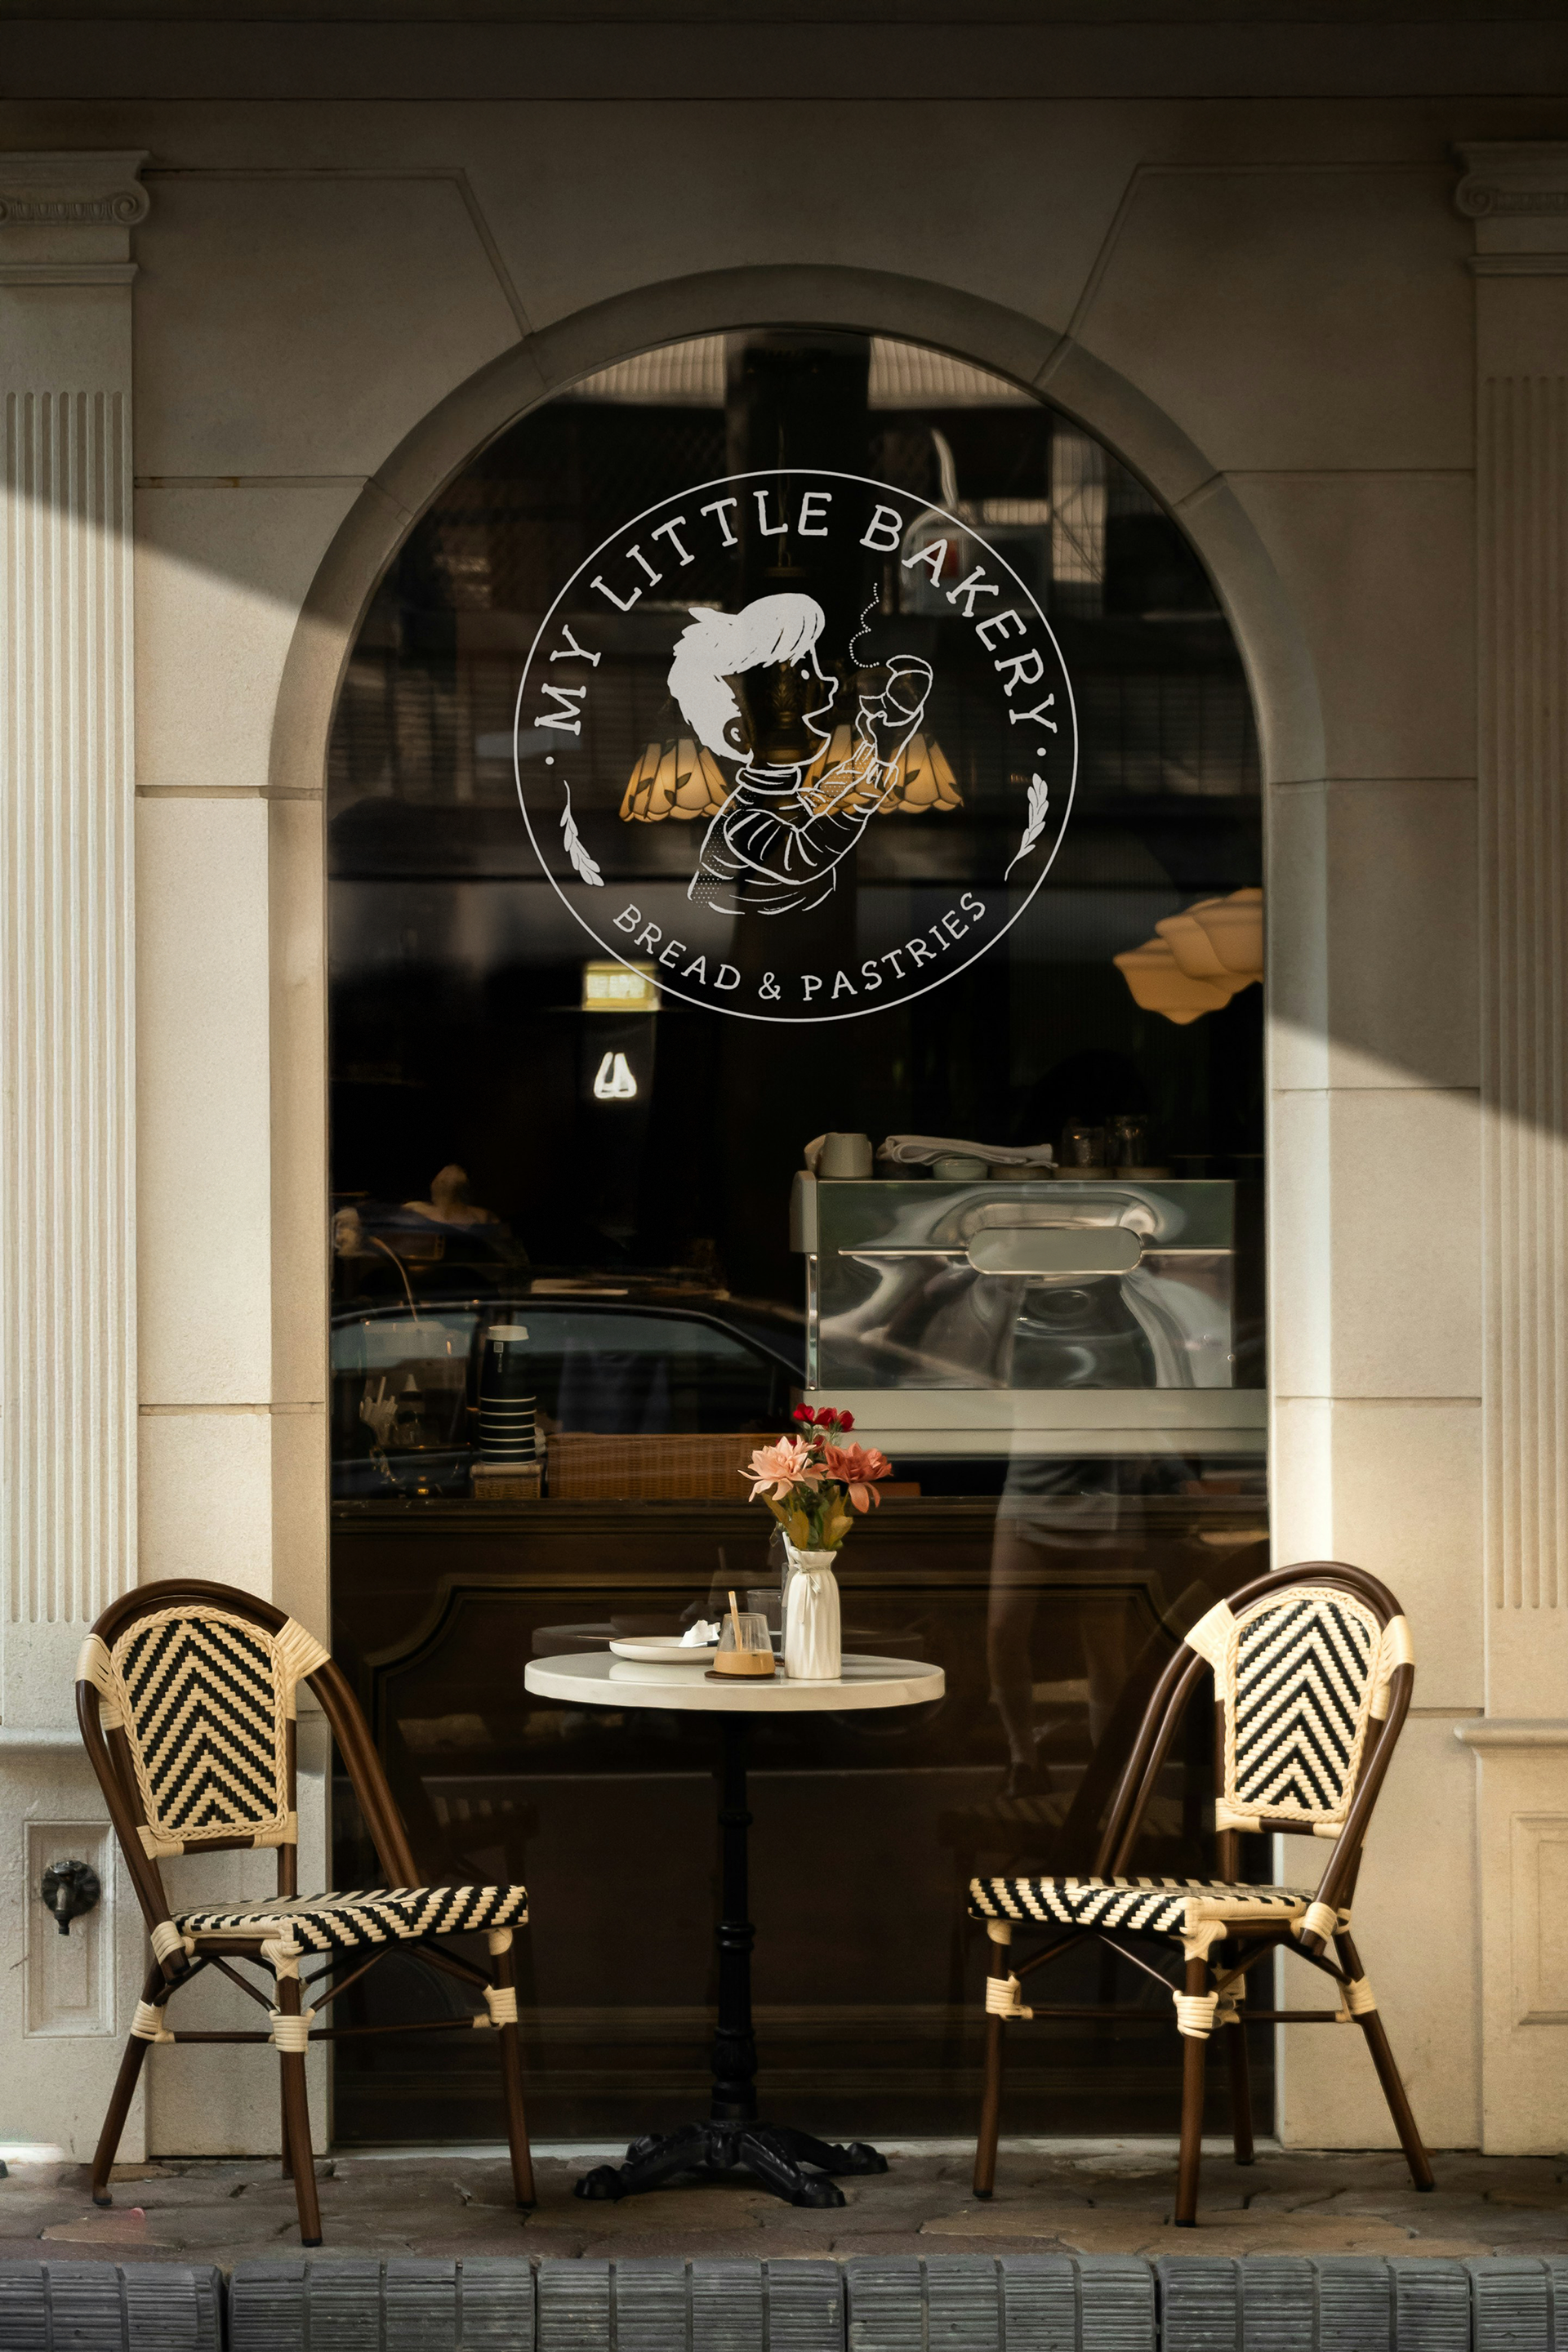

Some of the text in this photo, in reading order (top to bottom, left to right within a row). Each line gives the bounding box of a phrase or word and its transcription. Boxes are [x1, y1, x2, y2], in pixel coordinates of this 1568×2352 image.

[534, 490, 1058, 736] MY LITTLE BAKERY
[612, 892, 986, 1001] BREAD & PASTRIES
